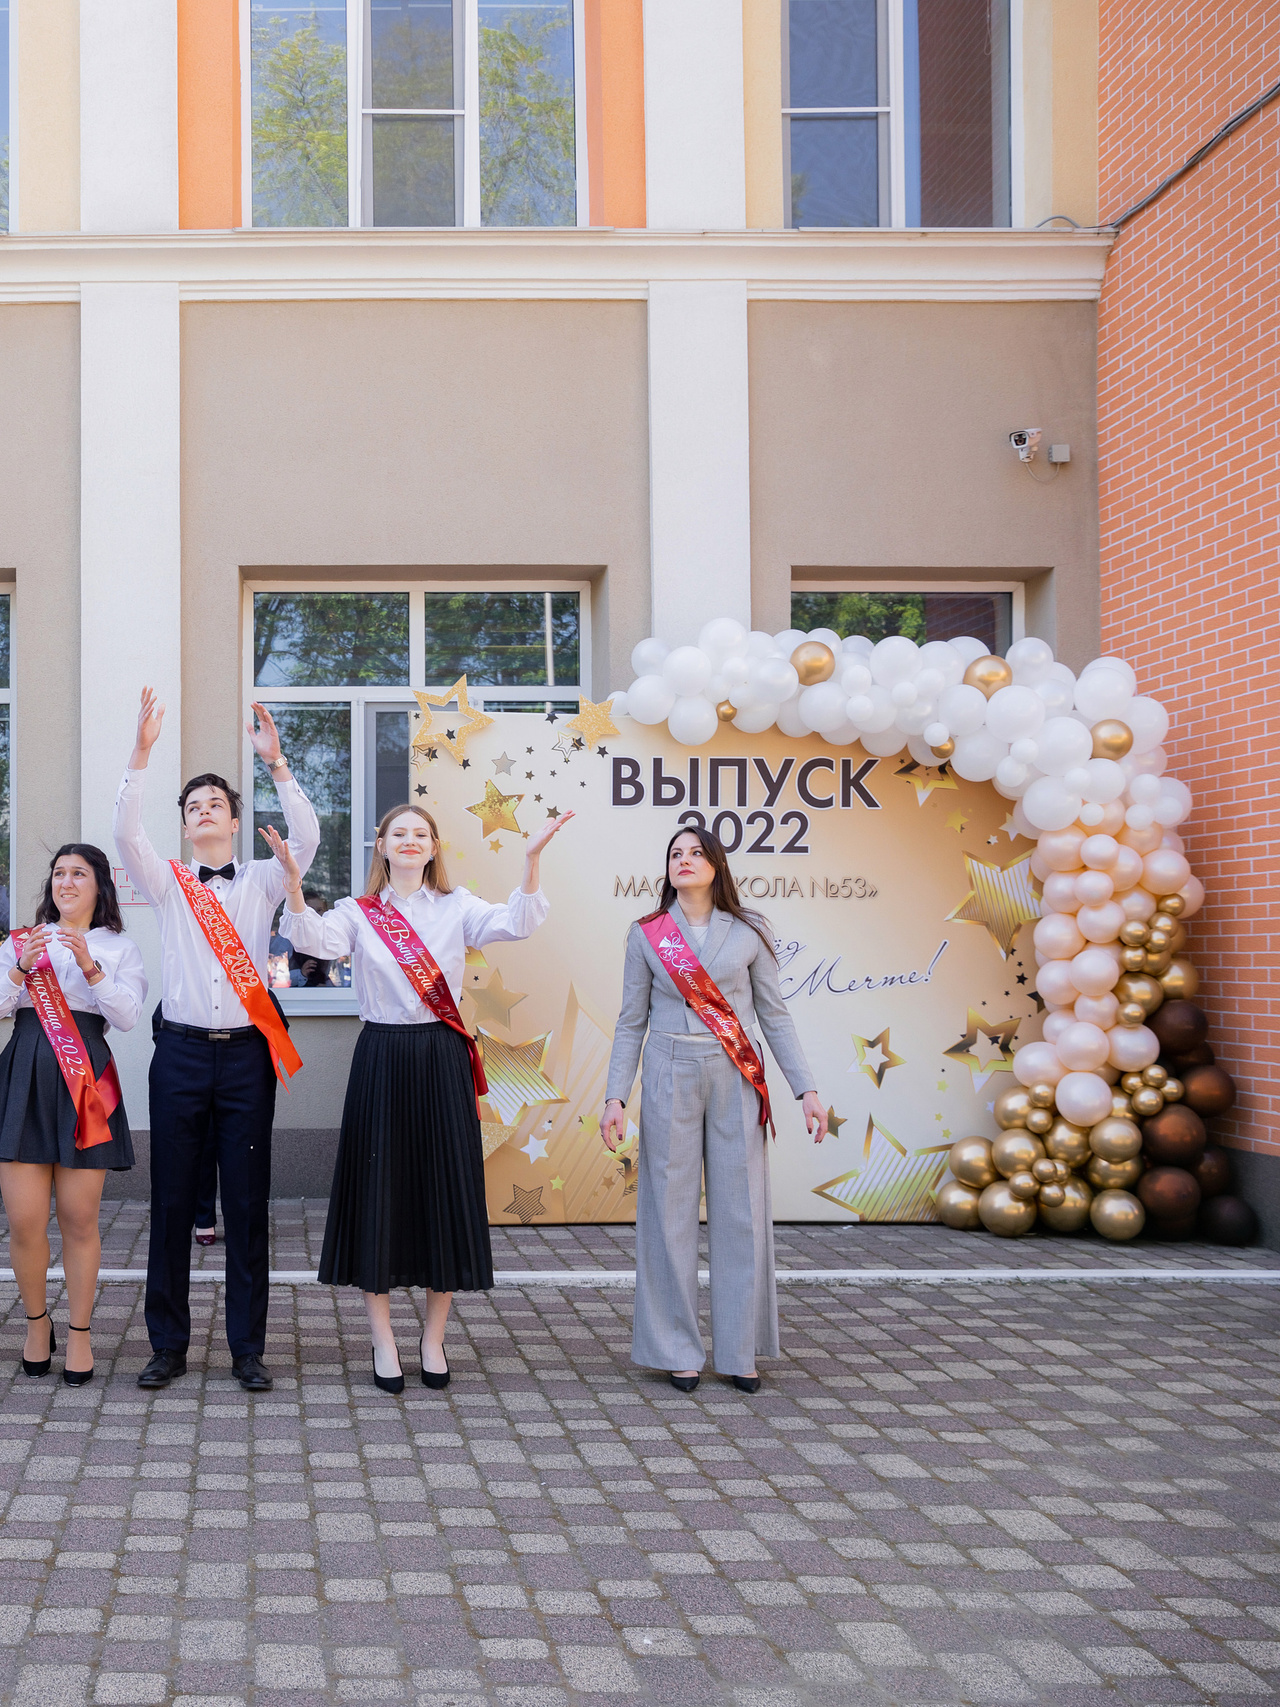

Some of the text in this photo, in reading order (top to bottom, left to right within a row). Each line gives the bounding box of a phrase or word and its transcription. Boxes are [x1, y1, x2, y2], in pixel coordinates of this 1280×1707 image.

[611, 756, 881, 809] ВЫПУСК
[223, 949, 260, 994] 2022
[383, 919, 439, 1005] Выпускница
[779, 940, 948, 1001] Мечте!
[671, 958, 708, 1003] Классный
[700, 1002, 745, 1058] руководитель
[743, 1060, 762, 1084] 2022
[56, 1035, 86, 1076] 2022
